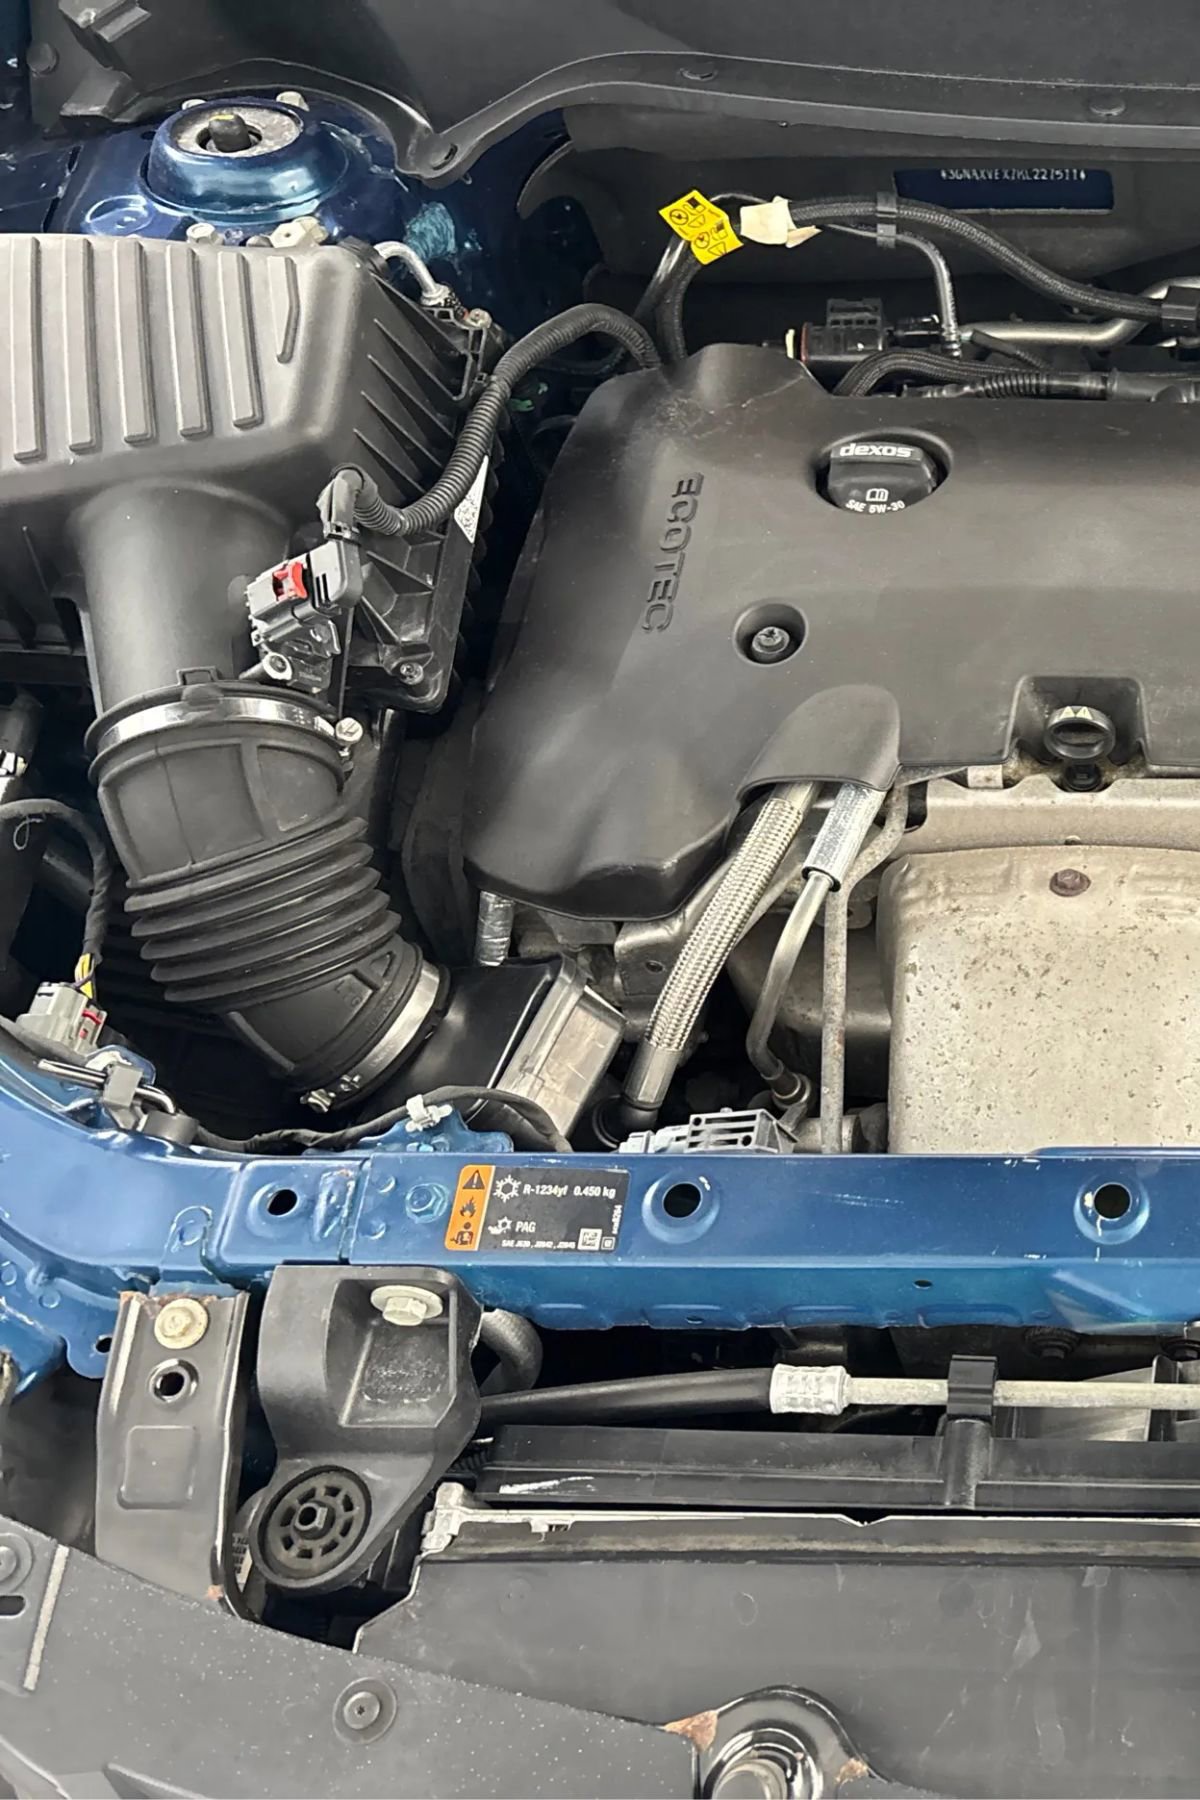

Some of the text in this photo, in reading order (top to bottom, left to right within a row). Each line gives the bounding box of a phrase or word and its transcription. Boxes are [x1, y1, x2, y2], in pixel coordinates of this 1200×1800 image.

[839, 443, 914, 458] dexos
[845, 500, 905, 513] SAE 5W-30
[642, 473, 704, 632] ECOTEC
[523, 1184, 616, 1199] R-1234yf 0.450 kg
[515, 1221, 536, 1233] PAG
